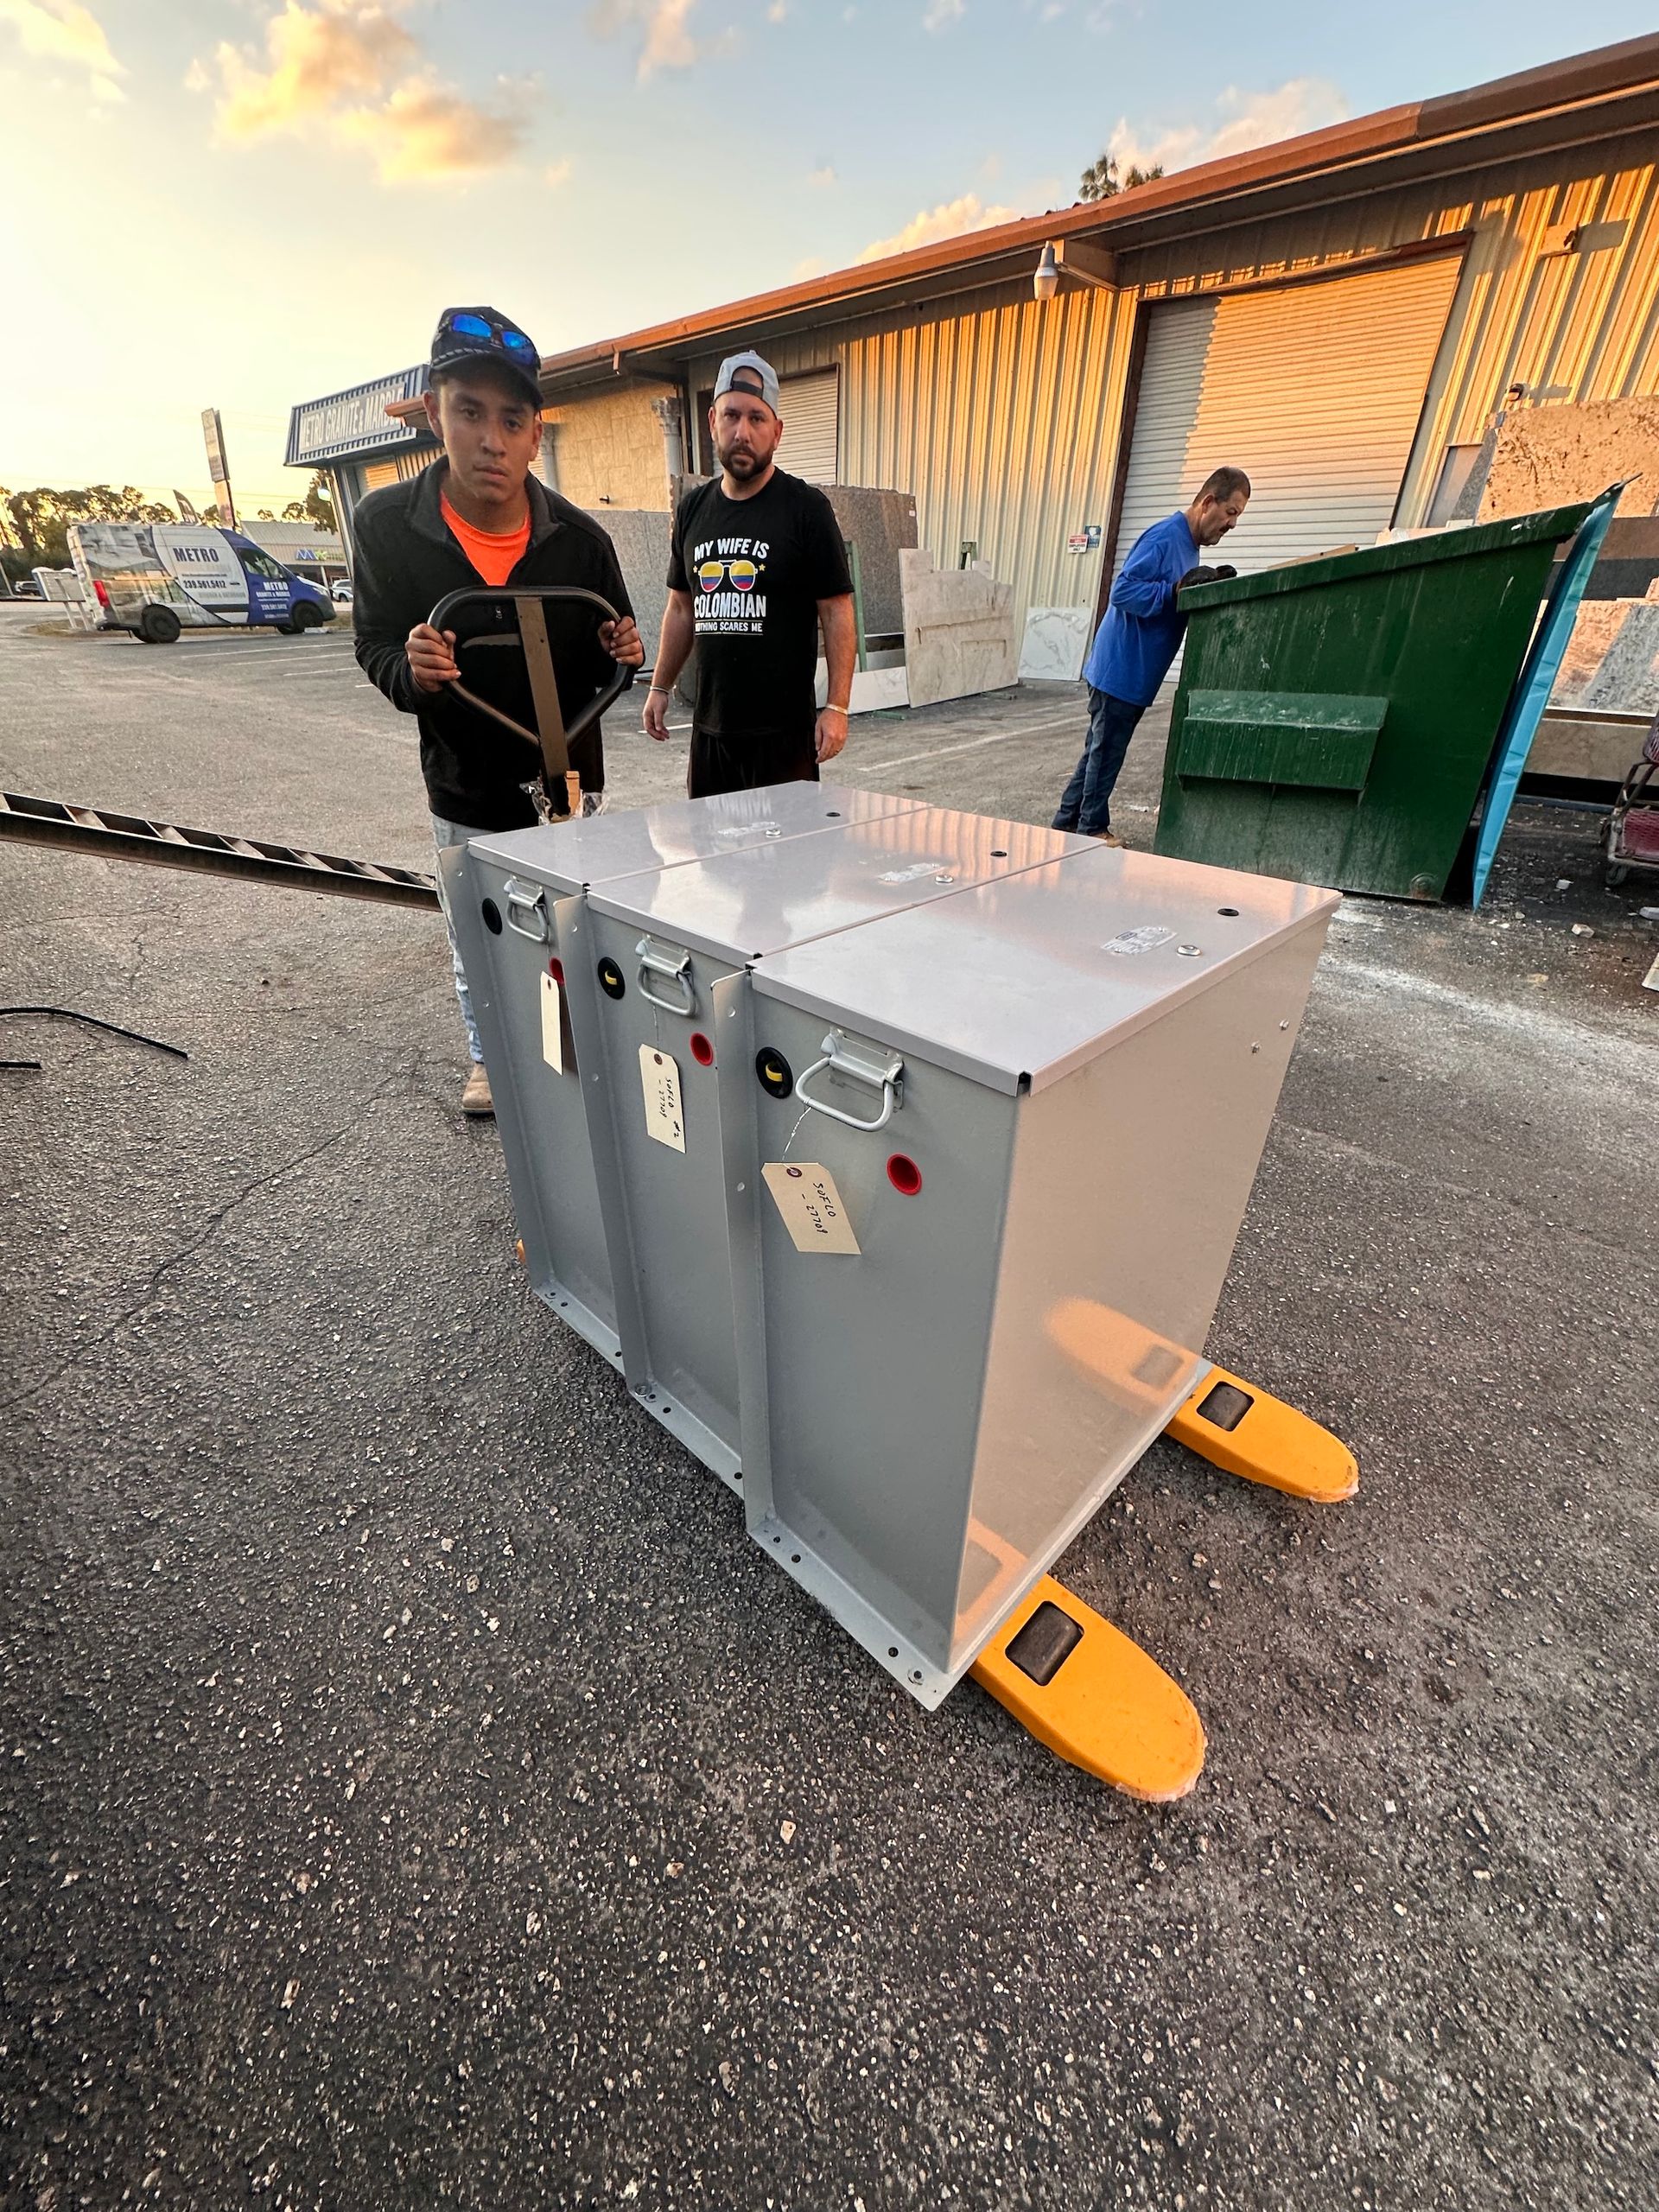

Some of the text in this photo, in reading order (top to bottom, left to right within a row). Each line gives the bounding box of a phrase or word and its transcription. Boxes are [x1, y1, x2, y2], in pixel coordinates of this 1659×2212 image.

[301, 412, 324, 448] METRO
[326, 400, 359, 442] GRANITE
[359, 409, 364, 433] &
[173, 548, 219, 563] METRO
[694, 537, 770, 562] MY WIFE IS
[263, 582, 289, 591] METRO
[694, 592, 766, 618] COLOMBIAN
[720, 621, 748, 632] SCARES
[751, 622, 763, 632] ME
[813, 1183, 836, 1217] SOFLO
